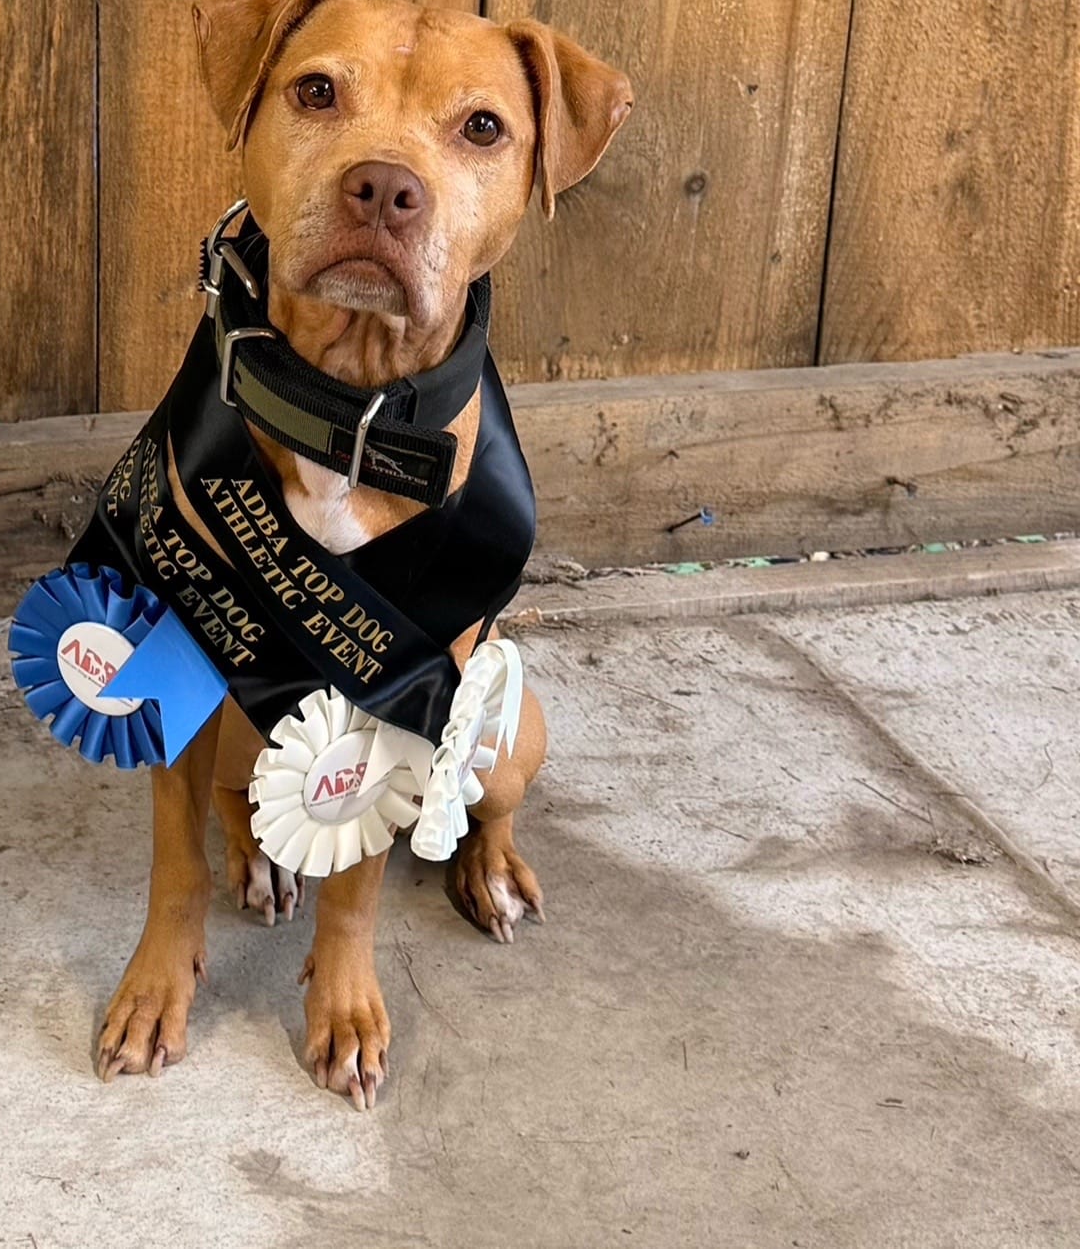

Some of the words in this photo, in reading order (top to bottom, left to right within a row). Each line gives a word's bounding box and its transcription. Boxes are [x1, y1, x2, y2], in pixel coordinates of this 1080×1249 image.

[162, 529, 213, 581] TOP
[209, 586, 266, 644] DOG
[176, 583, 257, 667] EVENT
[200, 477, 308, 611] ATHLETIC
[301, 610, 384, 684] EVENT
[230, 478, 289, 557] ADBA
[289, 555, 346, 605] TOP
[338, 603, 395, 653] DOG
